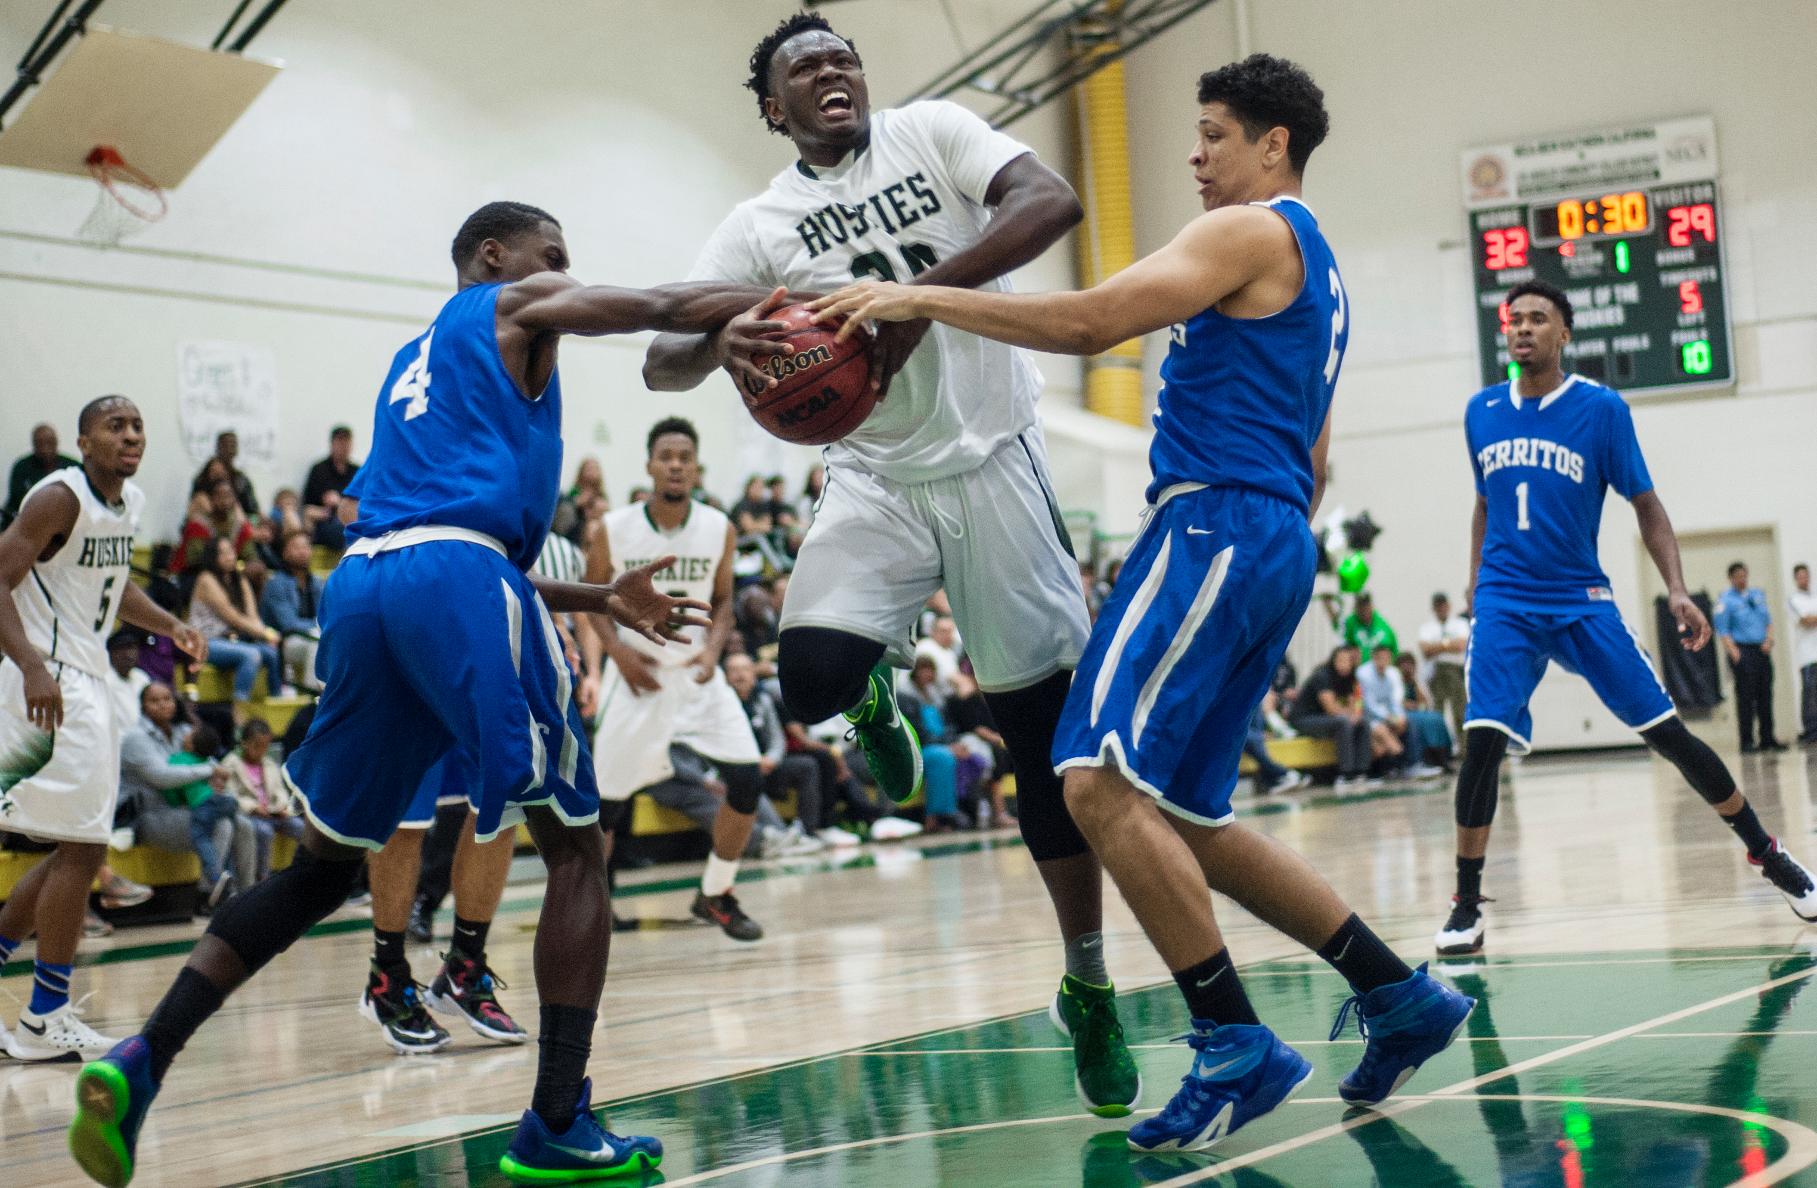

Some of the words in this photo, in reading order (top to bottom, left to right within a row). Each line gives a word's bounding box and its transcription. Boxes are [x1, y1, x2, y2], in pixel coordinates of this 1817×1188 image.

[797, 172, 941, 259] HUSIES
[1557, 192, 1647, 240] 0:30
[1667, 203, 1715, 247] 29
[1483, 226, 1529, 270] 32
[1614, 241, 1630, 273] 1
[1679, 280, 1703, 314] 5
[389, 325, 436, 422] 4
[1682, 340, 1713, 375] 10
[1515, 482, 1530, 531] 1
[94, 575, 115, 632] 5
